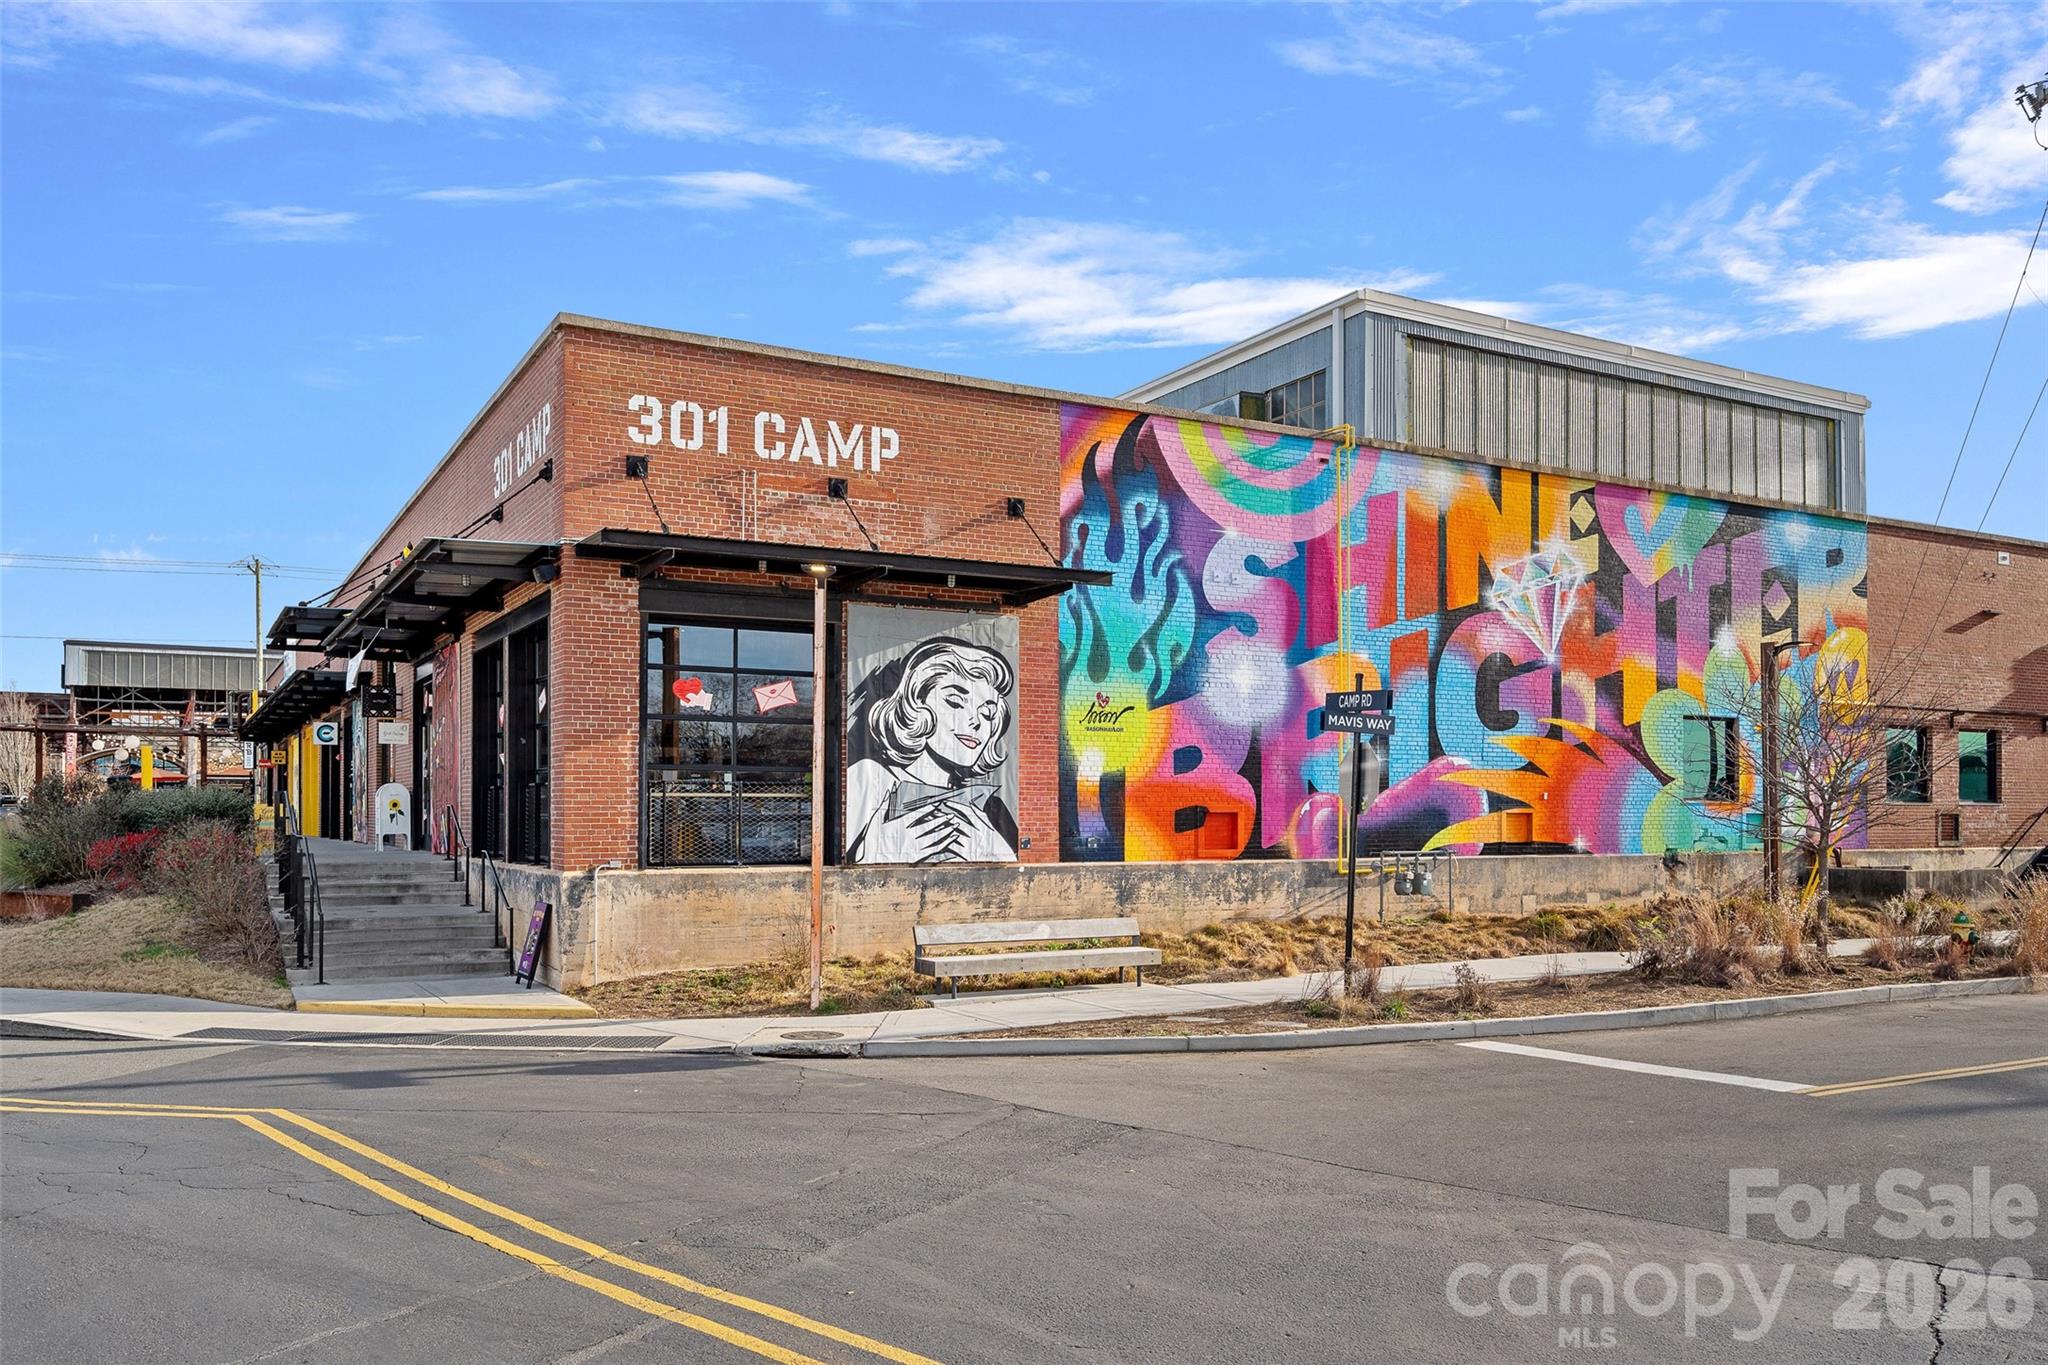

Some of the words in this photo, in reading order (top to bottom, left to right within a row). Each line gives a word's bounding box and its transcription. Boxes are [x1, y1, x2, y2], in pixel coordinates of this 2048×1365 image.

[493, 441, 513, 499] 301
[516, 403, 552, 477] CAMP
[627, 394, 729, 454] 301
[754, 411, 900, 472] CAMP
[1328, 714, 1363, 728] MAVIS
[1366, 718, 1392, 731] WAY
[1338, 694, 1360, 708] CAMP
[1361, 693, 1373, 707] RD
